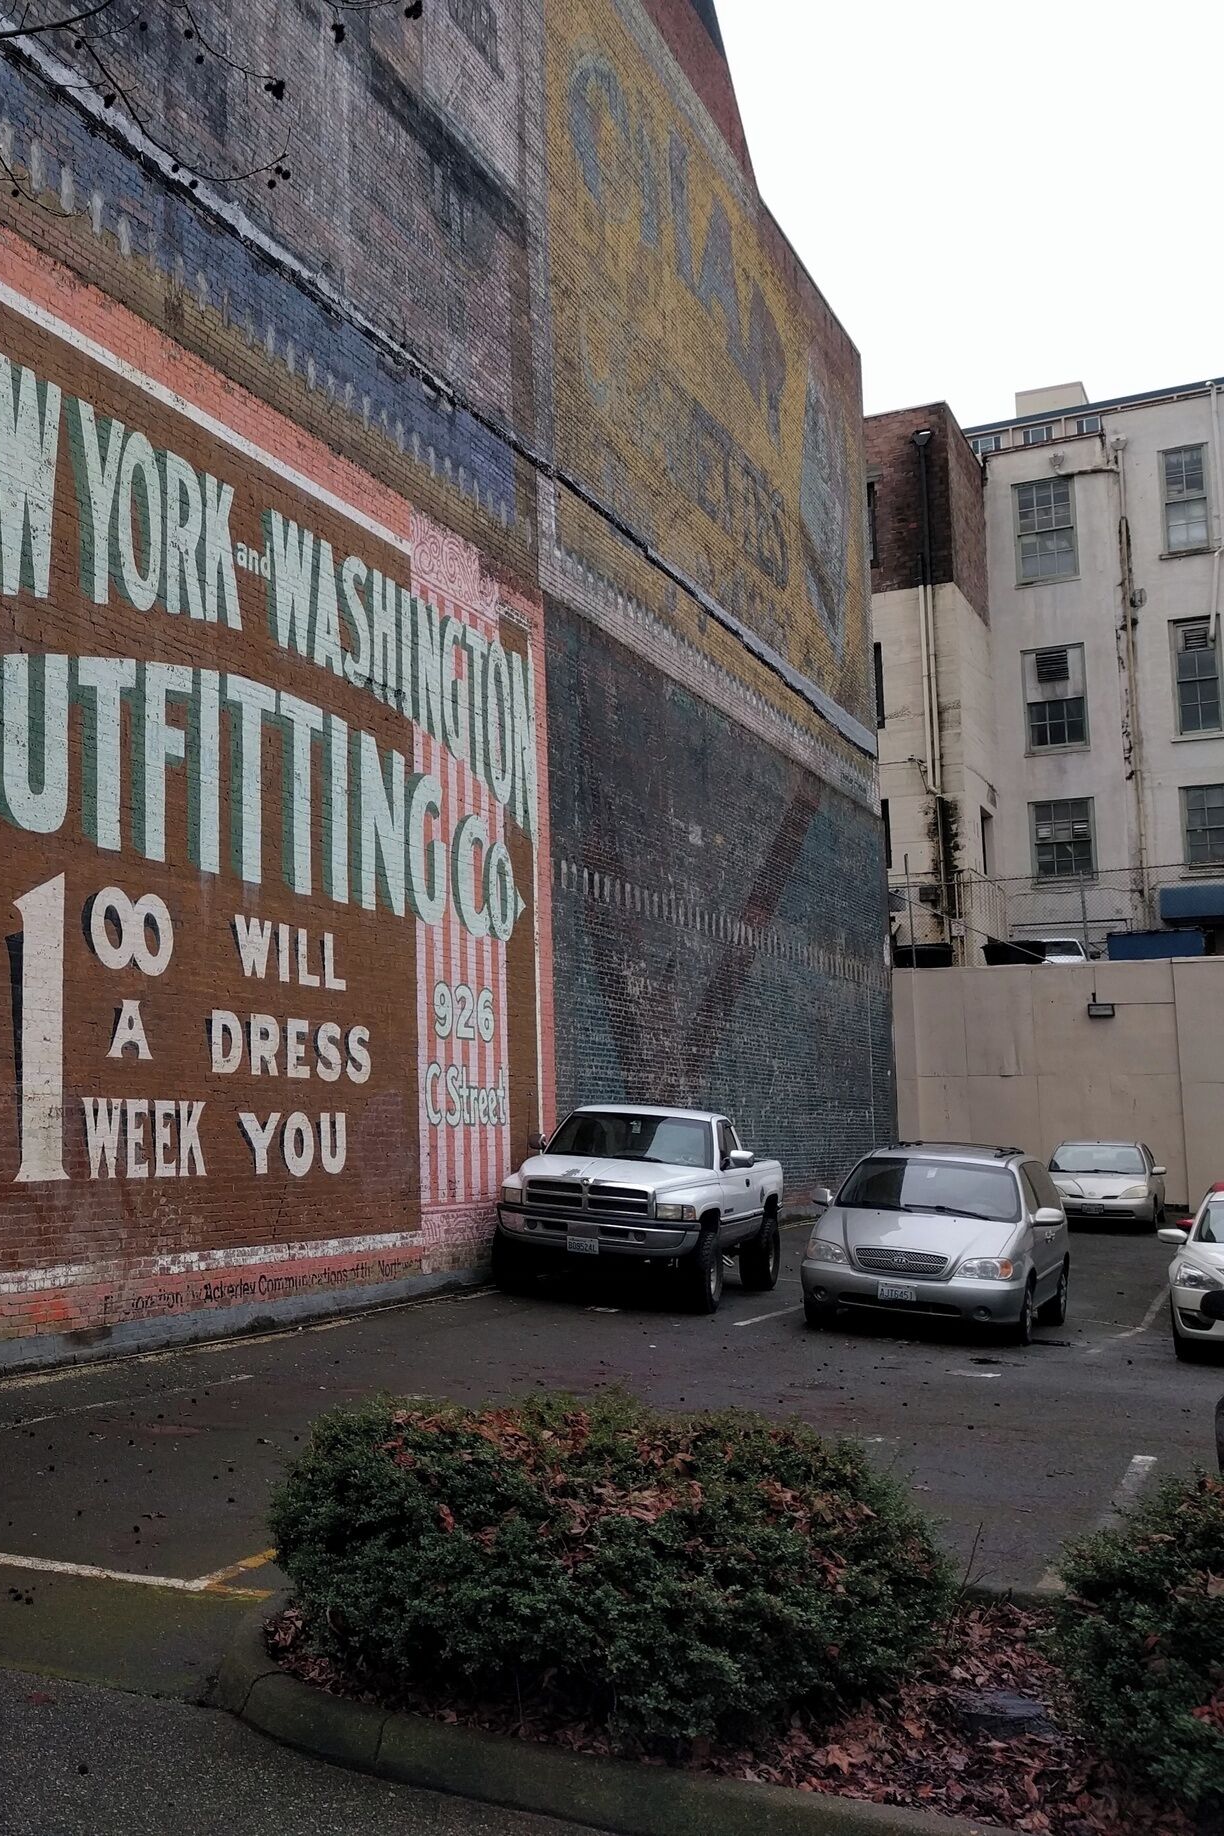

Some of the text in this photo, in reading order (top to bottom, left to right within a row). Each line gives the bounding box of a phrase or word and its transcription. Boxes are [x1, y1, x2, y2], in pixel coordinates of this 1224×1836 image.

[67, 397, 243, 632] YORK
[236, 540, 272, 583] and
[264, 508, 536, 842] WASHINGTON
[231, 914, 347, 991] WILL
[106, 1000, 153, 1060] A
[206, 1008, 371, 1084] DRESS
[433, 980, 495, 1043] 926
[425, 1060, 508, 1129] C Street
[81, 1096, 207, 1180] WEEK
[239, 1111, 347, 1177] YOU
[879, 1287, 913, 1300] AJT6451
